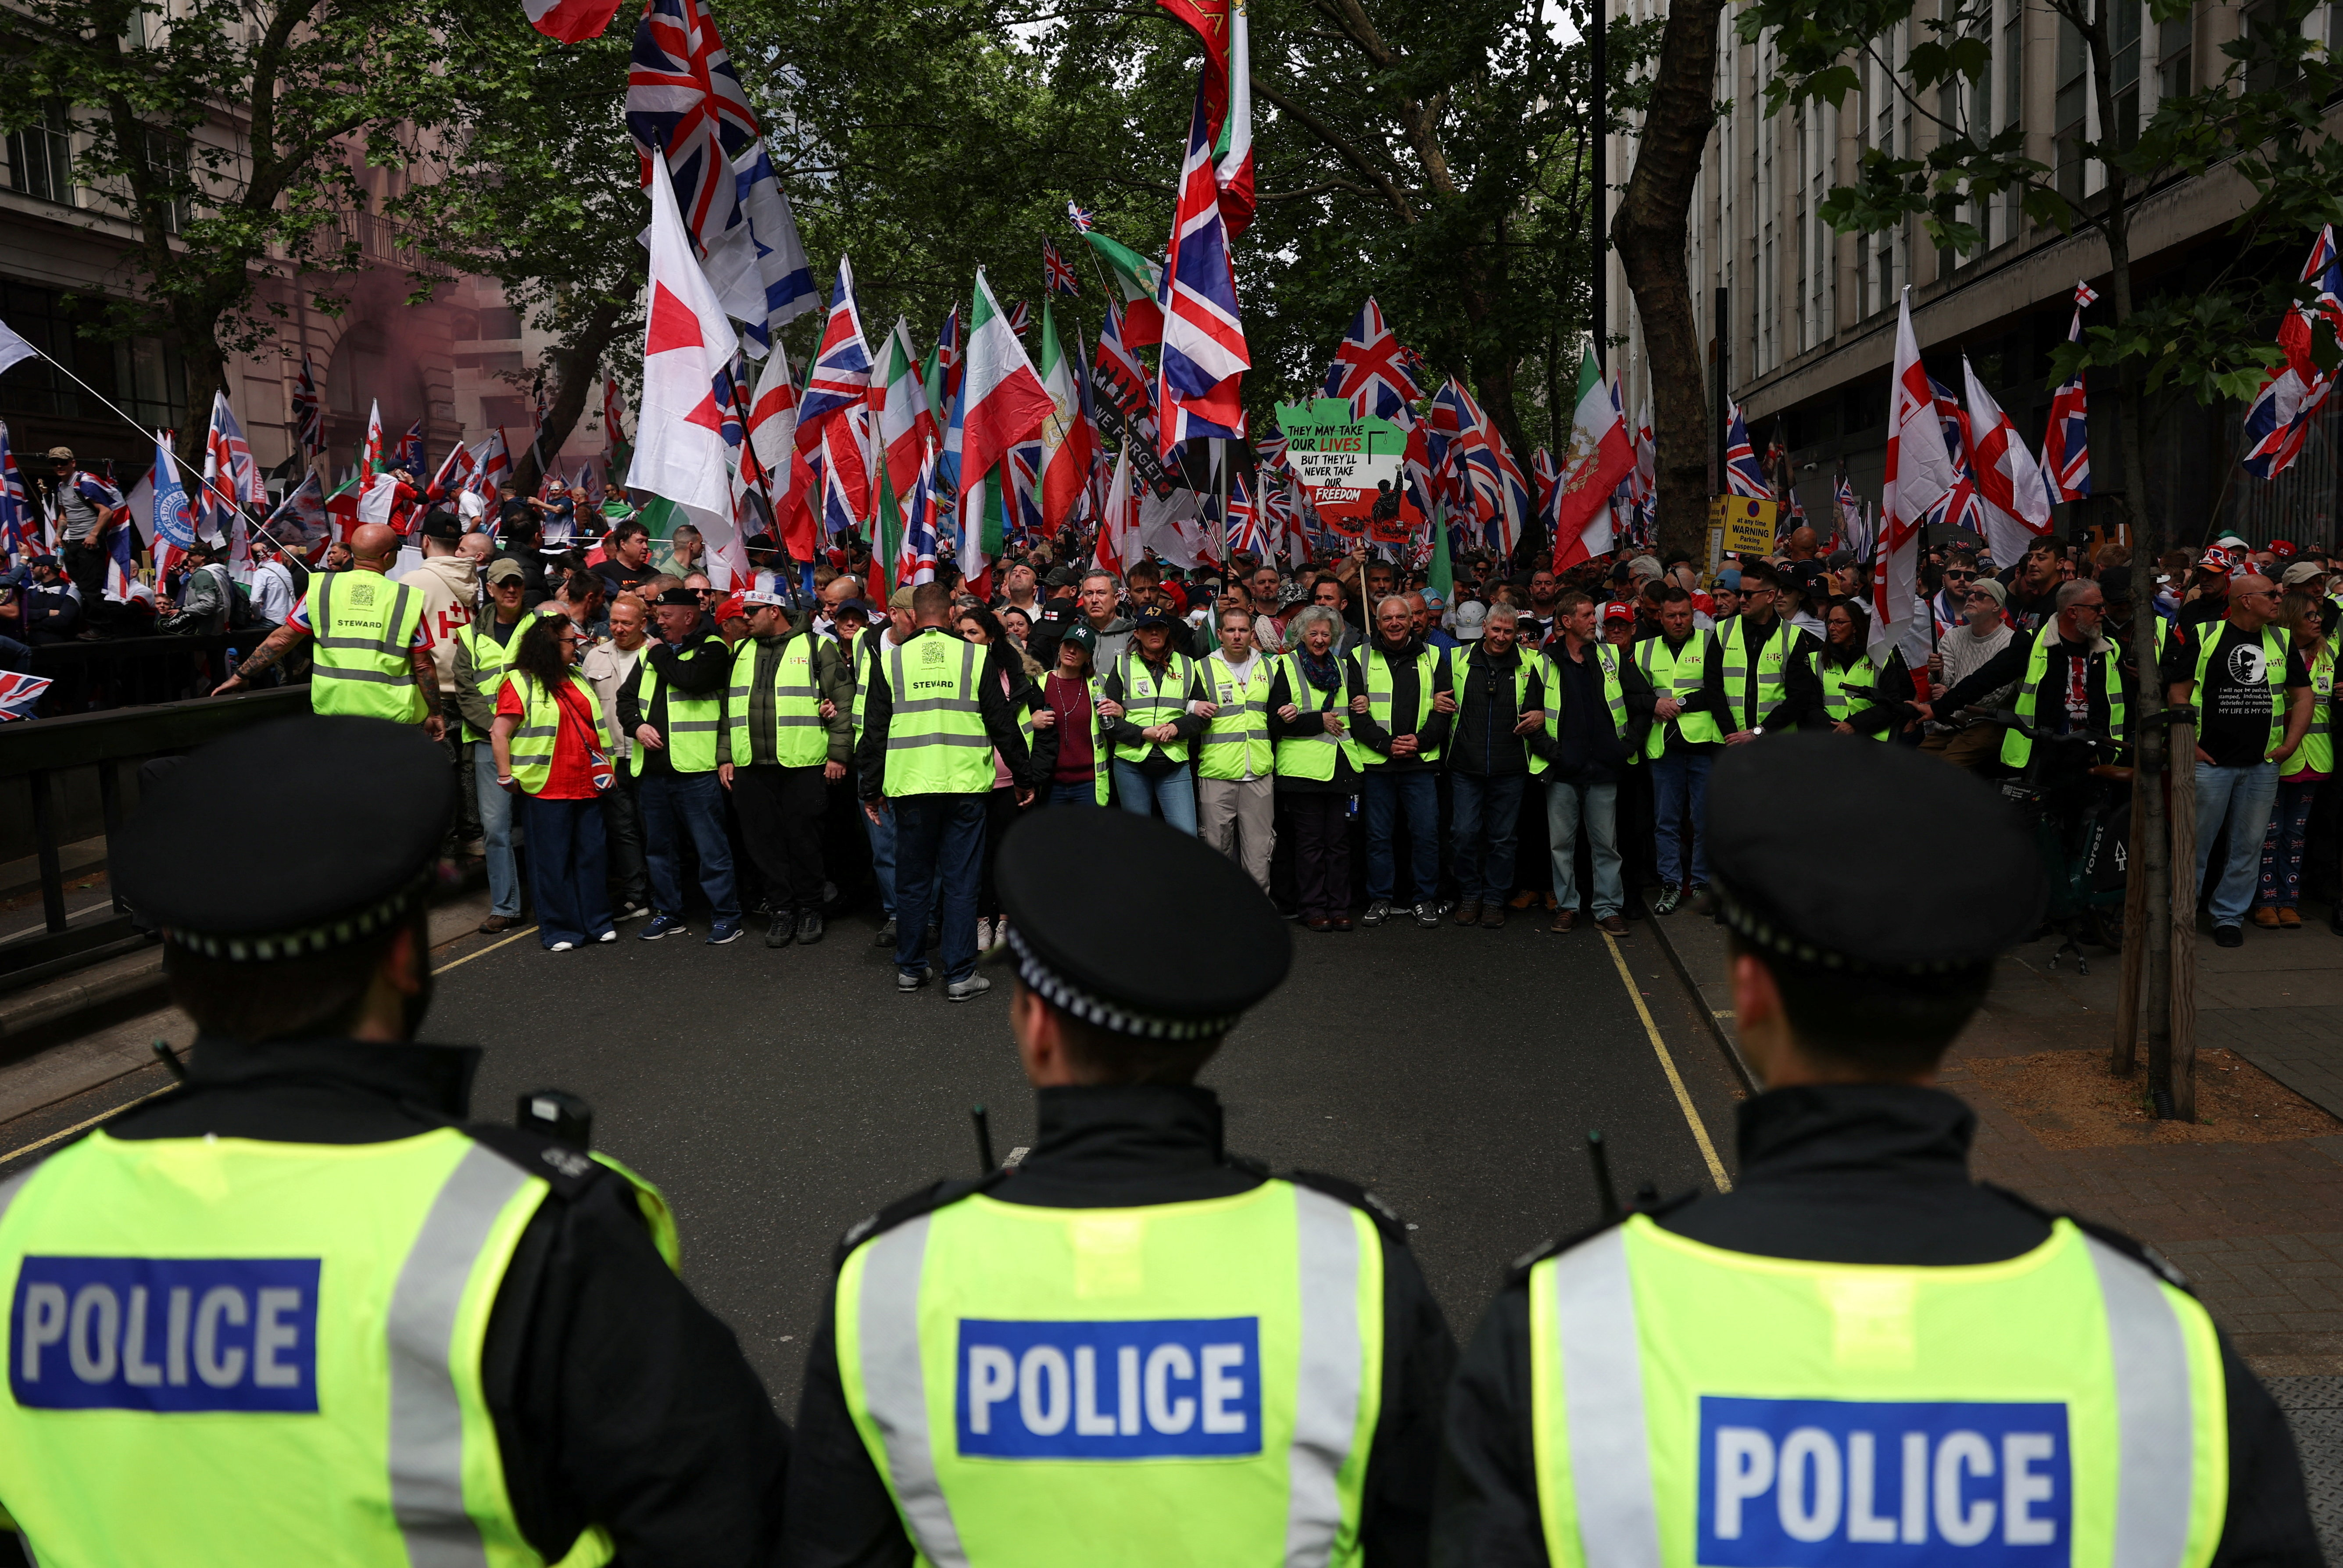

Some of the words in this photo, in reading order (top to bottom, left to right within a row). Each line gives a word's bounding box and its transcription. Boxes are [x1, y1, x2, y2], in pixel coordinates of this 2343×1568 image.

[1287, 425, 1312, 437] THEY
[1315, 425, 1335, 436] MAY
[1339, 425, 1364, 436] TAKE
[1095, 404, 1114, 428] WE
[1112, 425, 1164, 481] FORGET
[1291, 438, 1316, 451] OUR
[1320, 437, 1361, 452] LIVES
[1301, 455, 1319, 465] BUT
[1322, 454, 1357, 465] THEY'LL
[1305, 466, 1331, 476] NEVER
[1334, 466, 1354, 476] TAKE
[1325, 477, 1341, 487] OUR
[1315, 487, 1361, 502] FREEDOM
[1732, 525, 1769, 538] WARNING
[1740, 536, 1760, 545] Parking
[1734, 544, 1764, 552] suspension
[1145, 606, 1162, 616] 47
[337, 619, 382, 628] STEWARD
[1075, 627, 1087, 638] NY
[913, 680, 954, 689] STEWARD
[2085, 825, 2104, 875] forest
[21, 1282, 302, 1388] POLICE
[968, 1343, 1247, 1437] POLICE
[1713, 1425, 2057, 1548] POLICE
